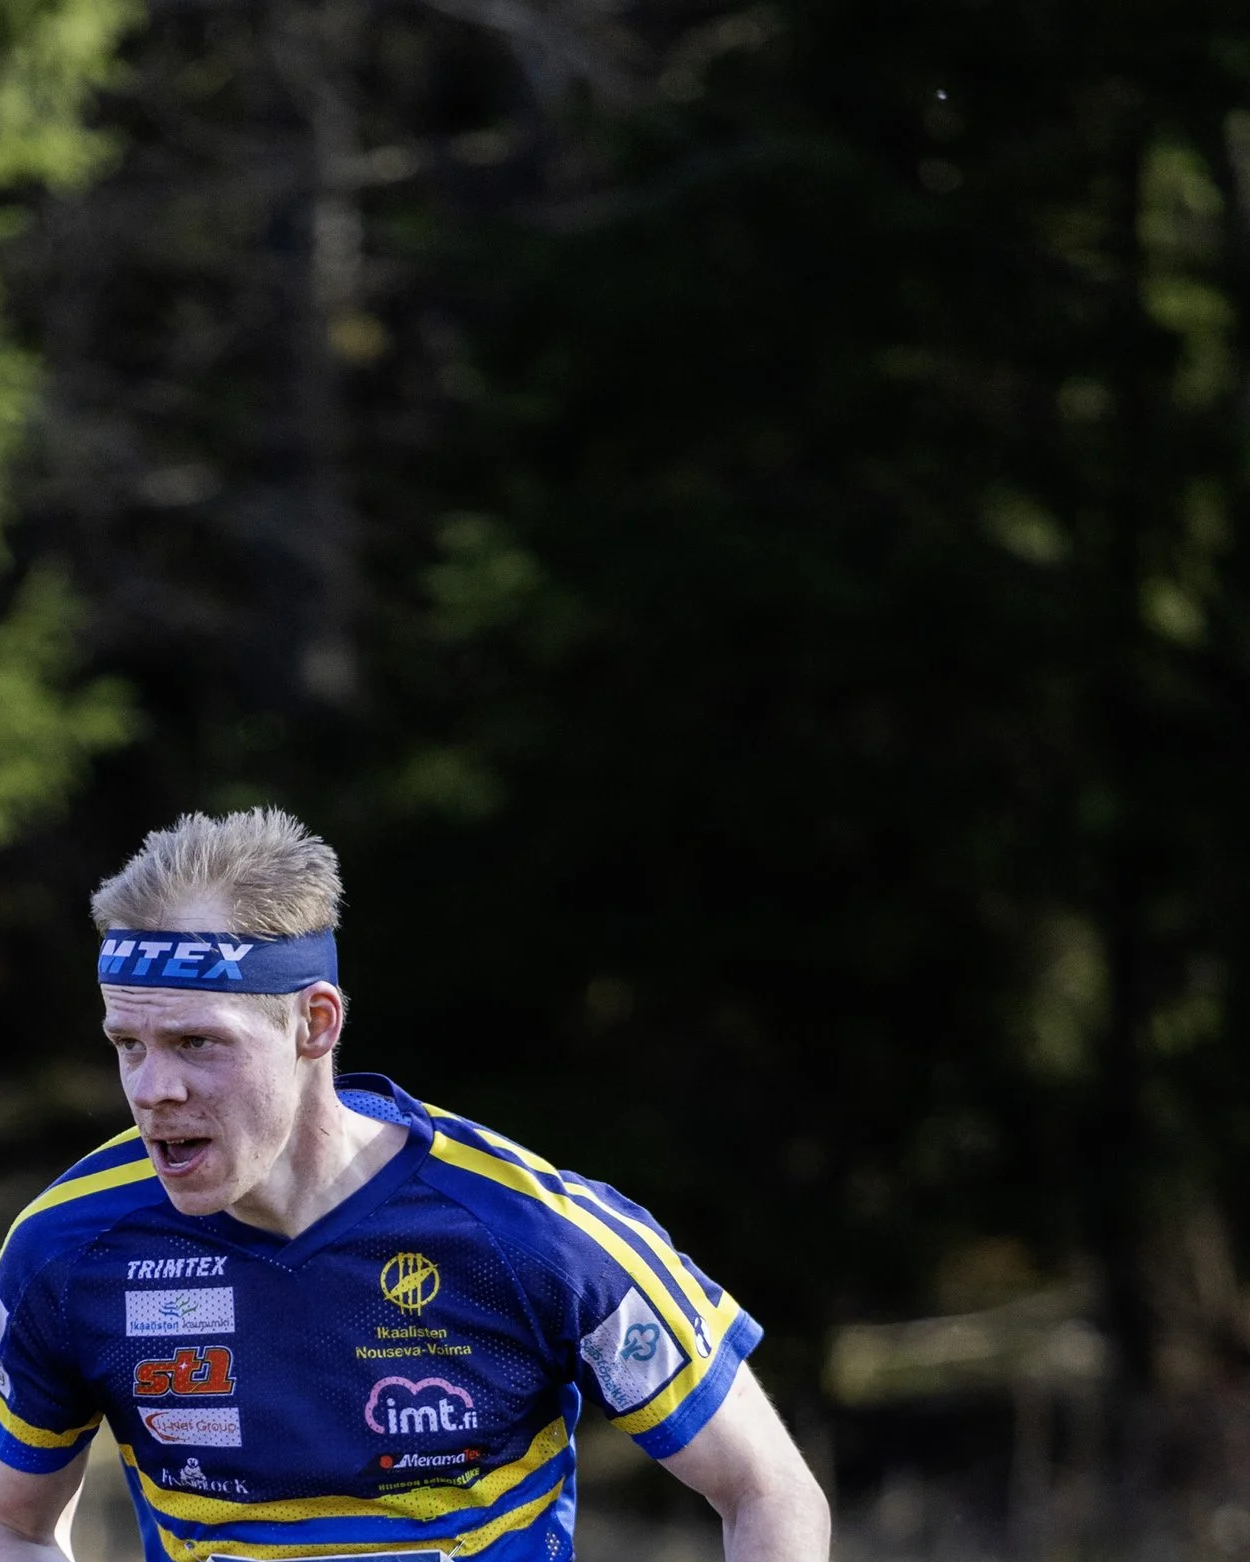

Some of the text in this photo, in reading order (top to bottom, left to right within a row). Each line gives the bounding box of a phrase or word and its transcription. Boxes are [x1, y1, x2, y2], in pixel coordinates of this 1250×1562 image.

[126, 1256, 228, 1280] TRIMTEX
[377, 1326, 447, 1340] Ikaalisten
[355, 1343, 472, 1360] Nouseva-Voima
[133, 1346, 237, 1397] st1
[386, 1398, 478, 1434] imt.fi
[196, 1421, 236, 1434] Group
